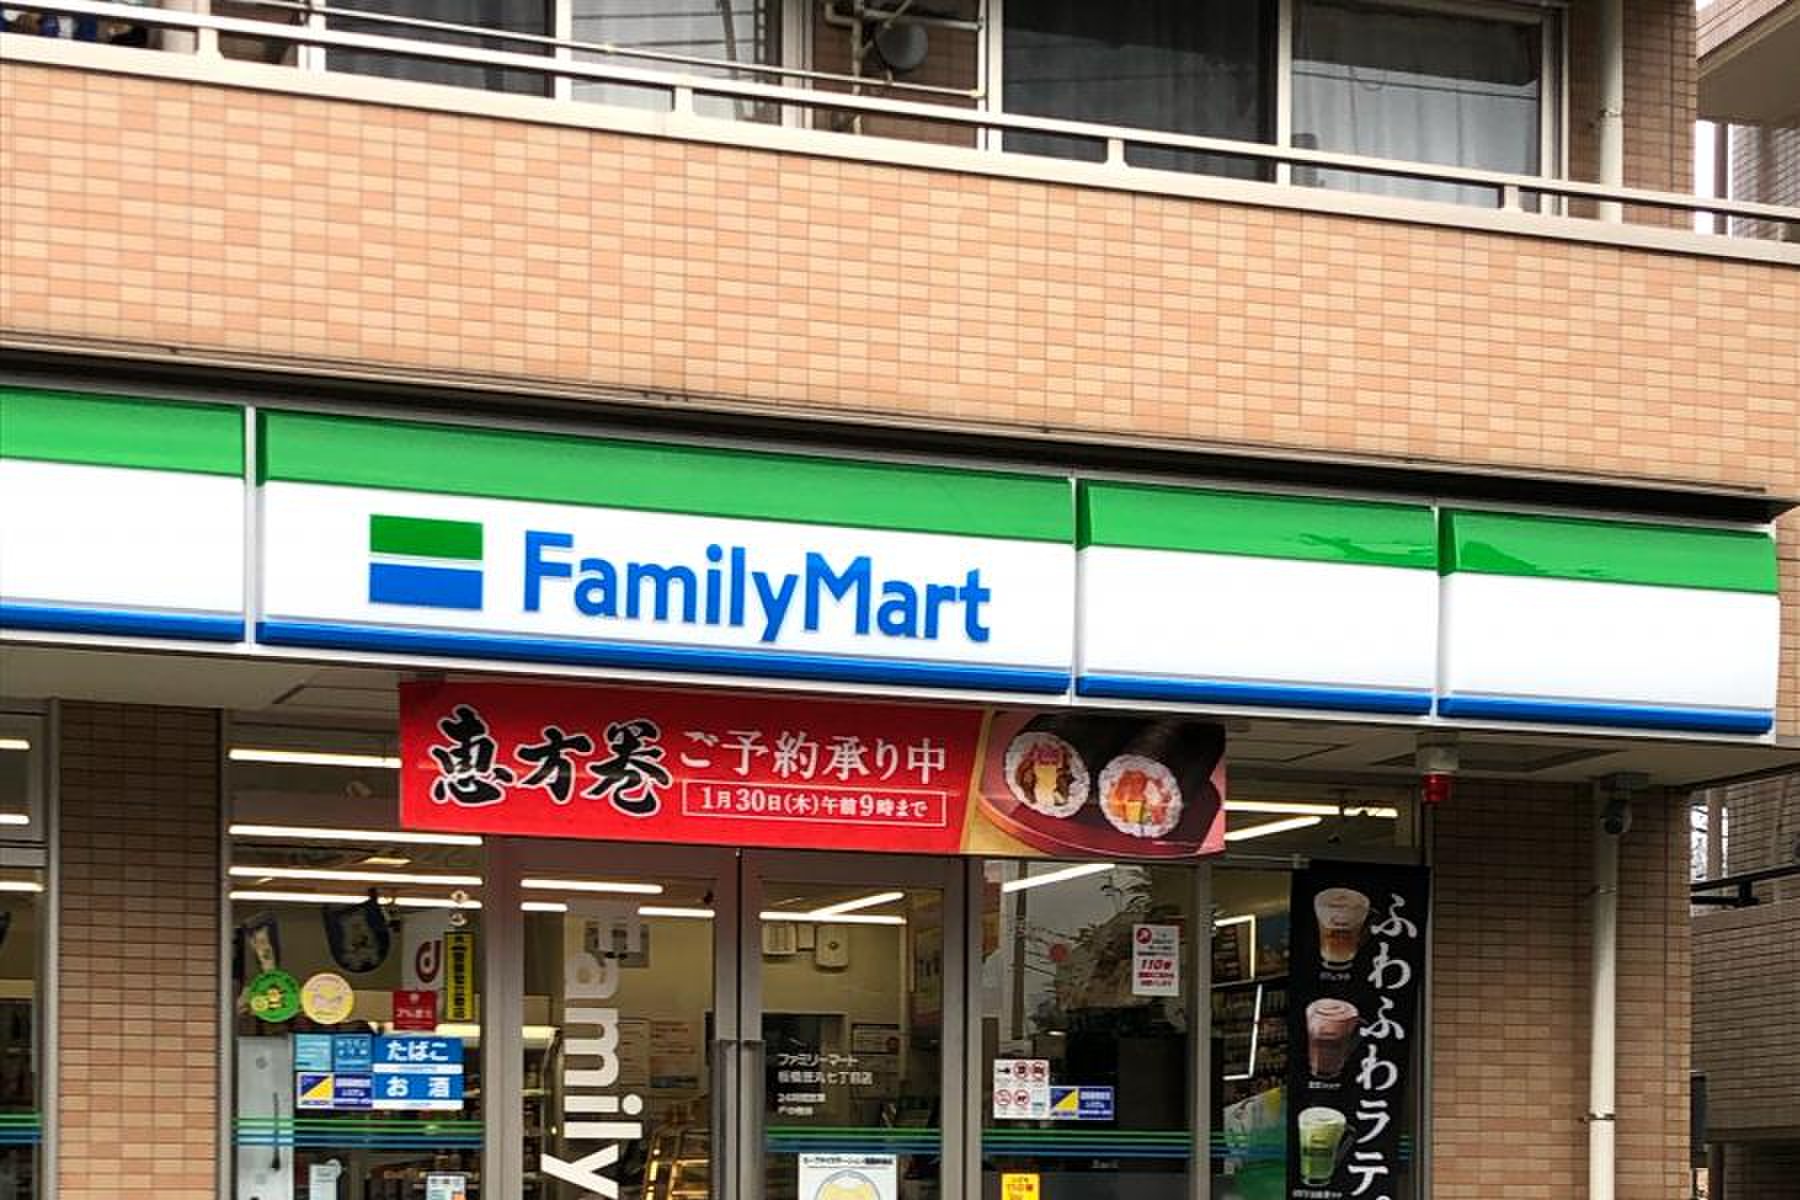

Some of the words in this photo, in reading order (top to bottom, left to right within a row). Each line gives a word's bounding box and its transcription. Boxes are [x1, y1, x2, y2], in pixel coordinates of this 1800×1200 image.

[523, 529, 990, 643] FamilyMart
[428, 703, 673, 817] 恵方巻
[680, 729, 946, 785] ご予約承り中
[702, 786, 929, 818] 1月30日(木)午前9時まで
[387, 1039, 449, 1062] たばこ
[778, 1053, 859, 1067] ファミリーマート
